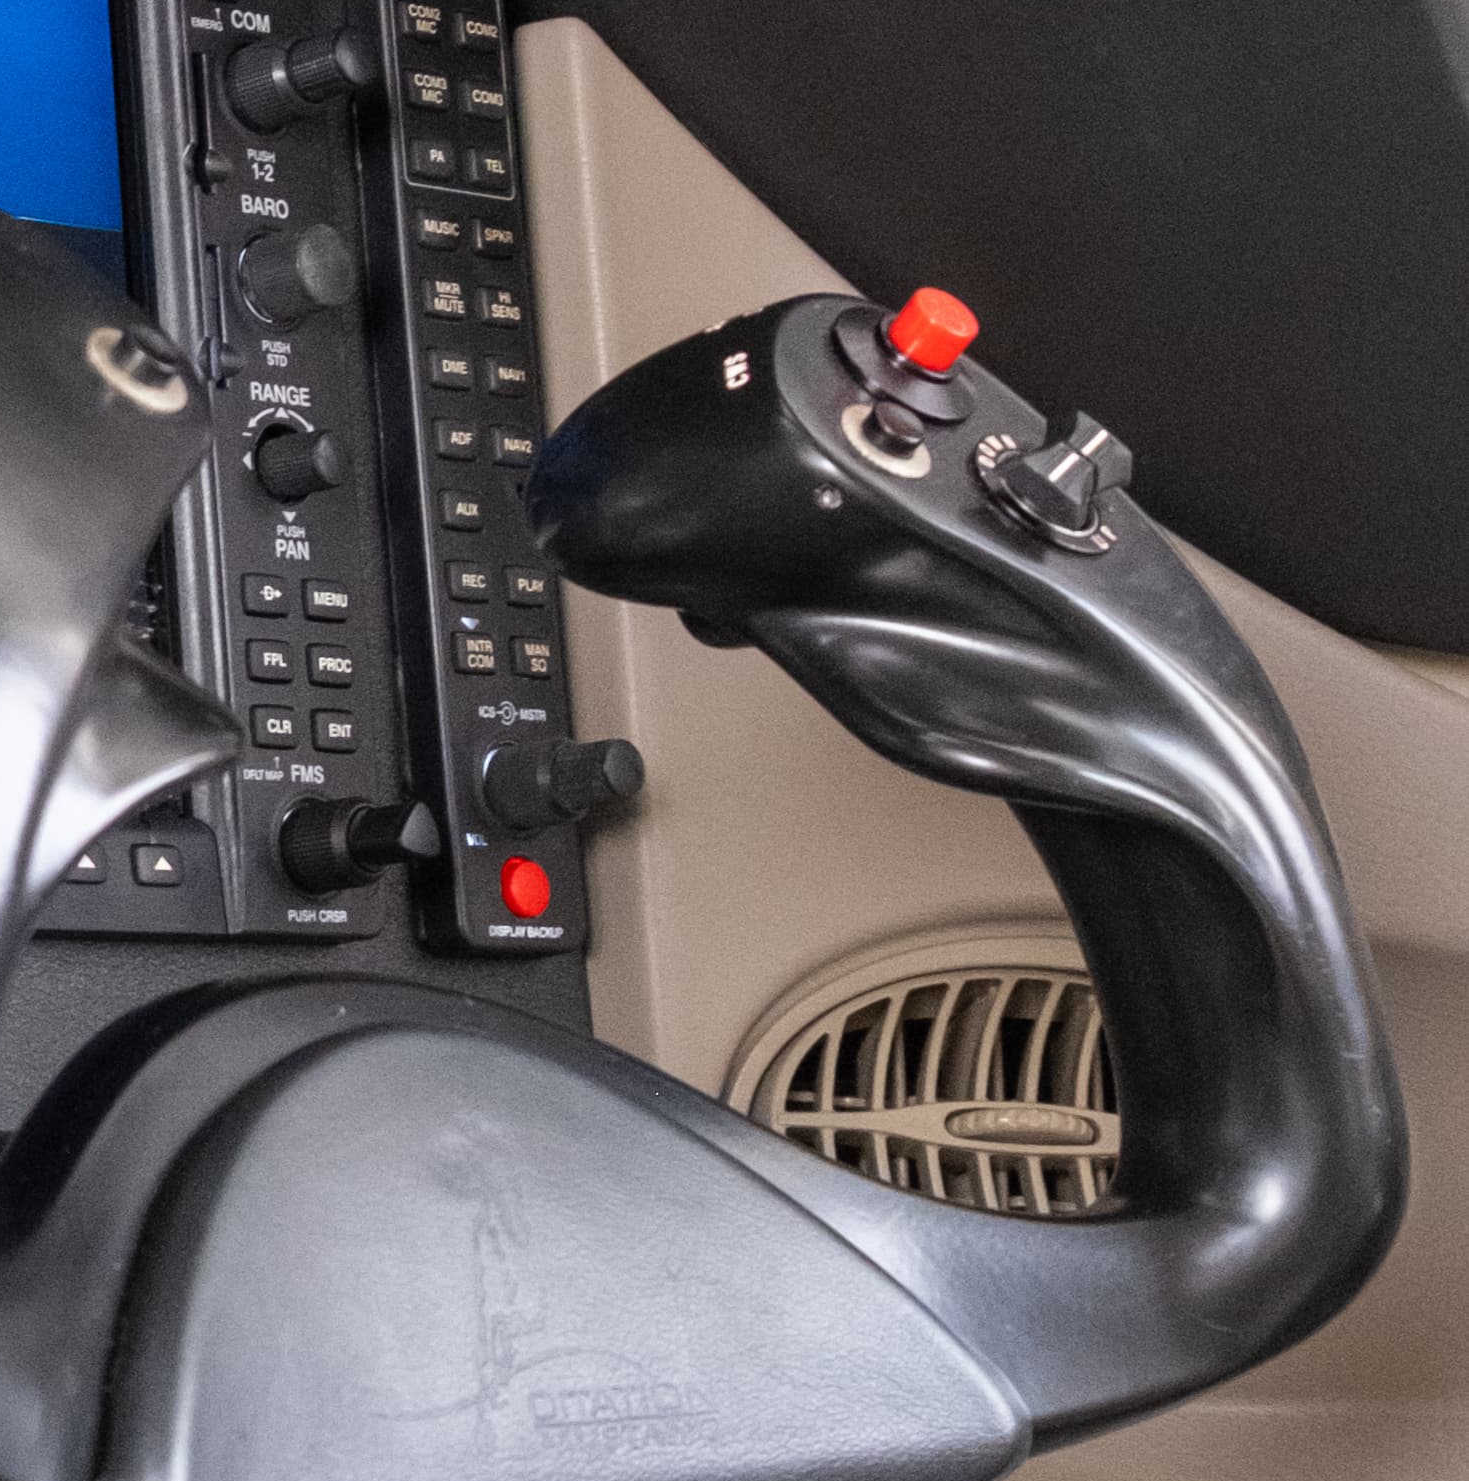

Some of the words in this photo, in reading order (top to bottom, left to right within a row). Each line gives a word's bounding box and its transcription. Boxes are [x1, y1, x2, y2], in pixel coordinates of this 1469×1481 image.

[230, 10, 270, 33] COM
[485, 159, 505, 173] TEL
[241, 195, 289, 219] BARO
[250, 382, 311, 407] RANGE
[275, 539, 310, 560] PAN
[313, 591, 348, 607] MENU
[263, 653, 287, 667] FPL
[319, 657, 352, 673] PROC
[267, 719, 292, 734] CLR
[329, 724, 352, 738] ENT
[291, 765, 324, 784] FMS
